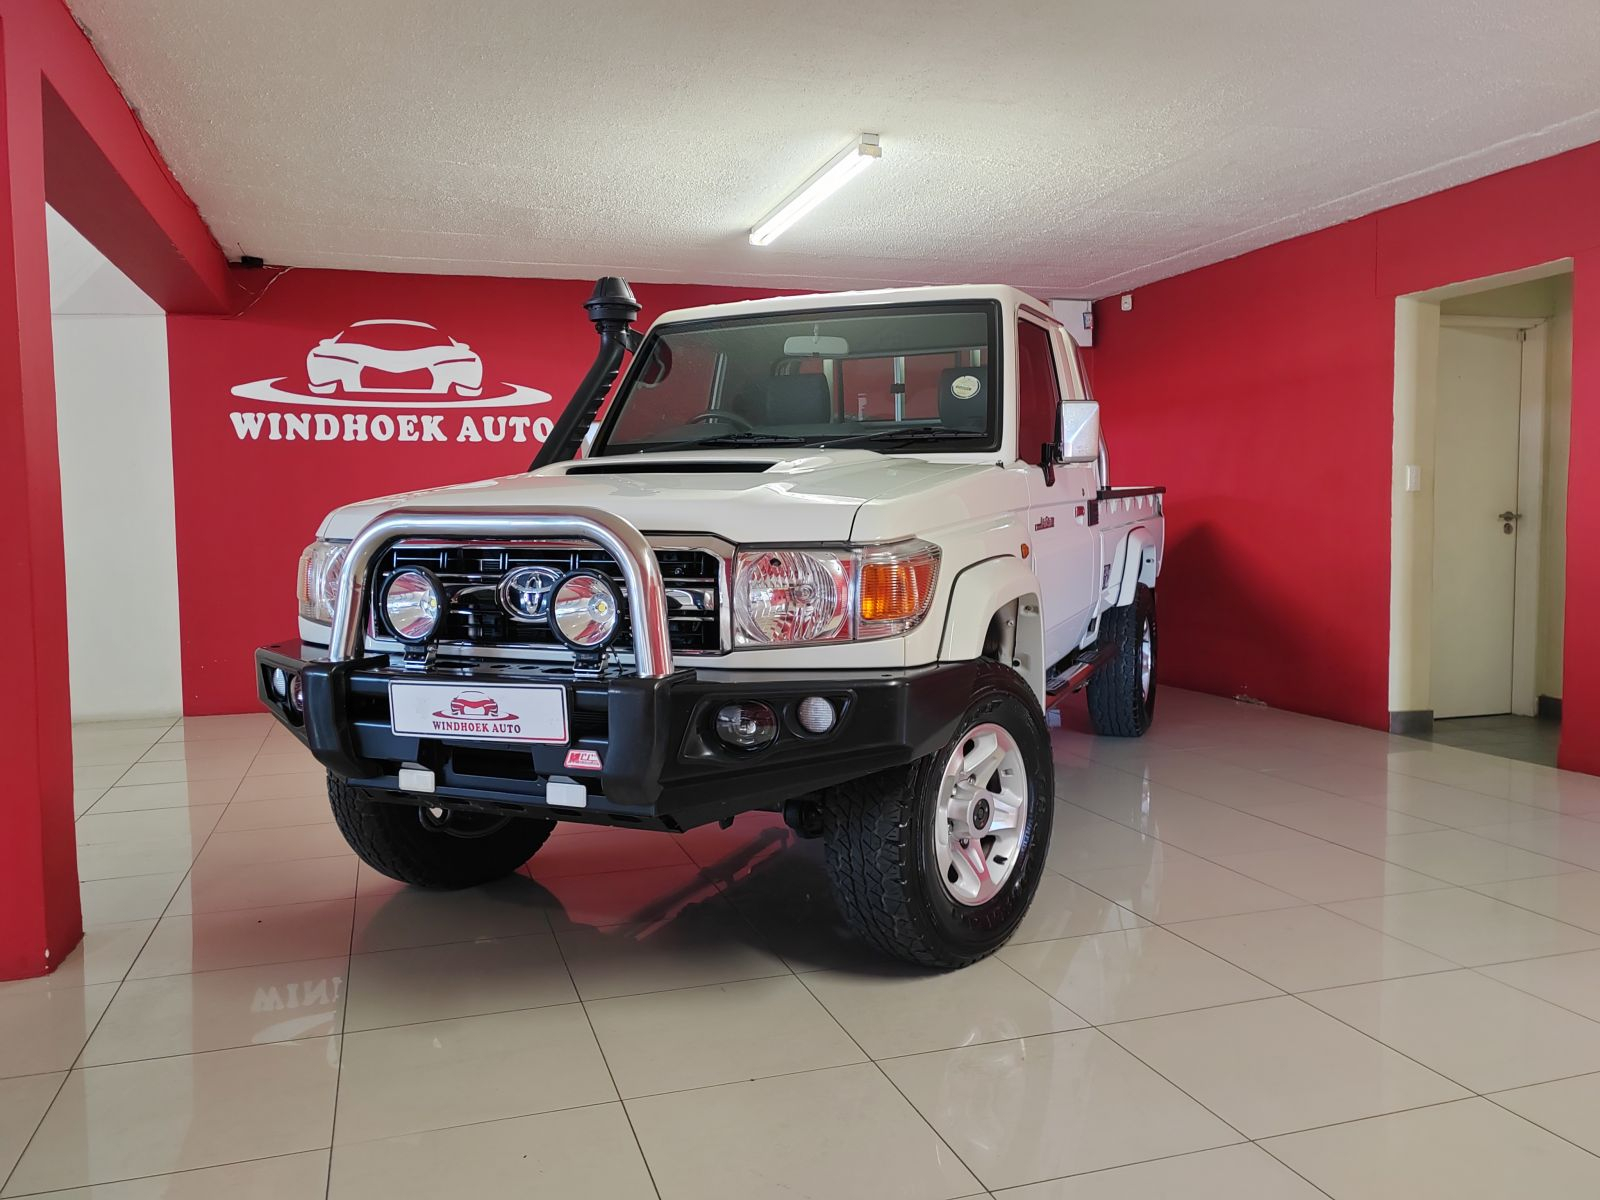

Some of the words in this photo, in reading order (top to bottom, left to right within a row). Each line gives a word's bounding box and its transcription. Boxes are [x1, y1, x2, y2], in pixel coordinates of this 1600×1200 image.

[229, 412, 448, 441] WINDHOEK
[456, 415, 555, 444] AUTO
[432, 721, 489, 733] WINDHOEK
[492, 723, 521, 734] AUTO
